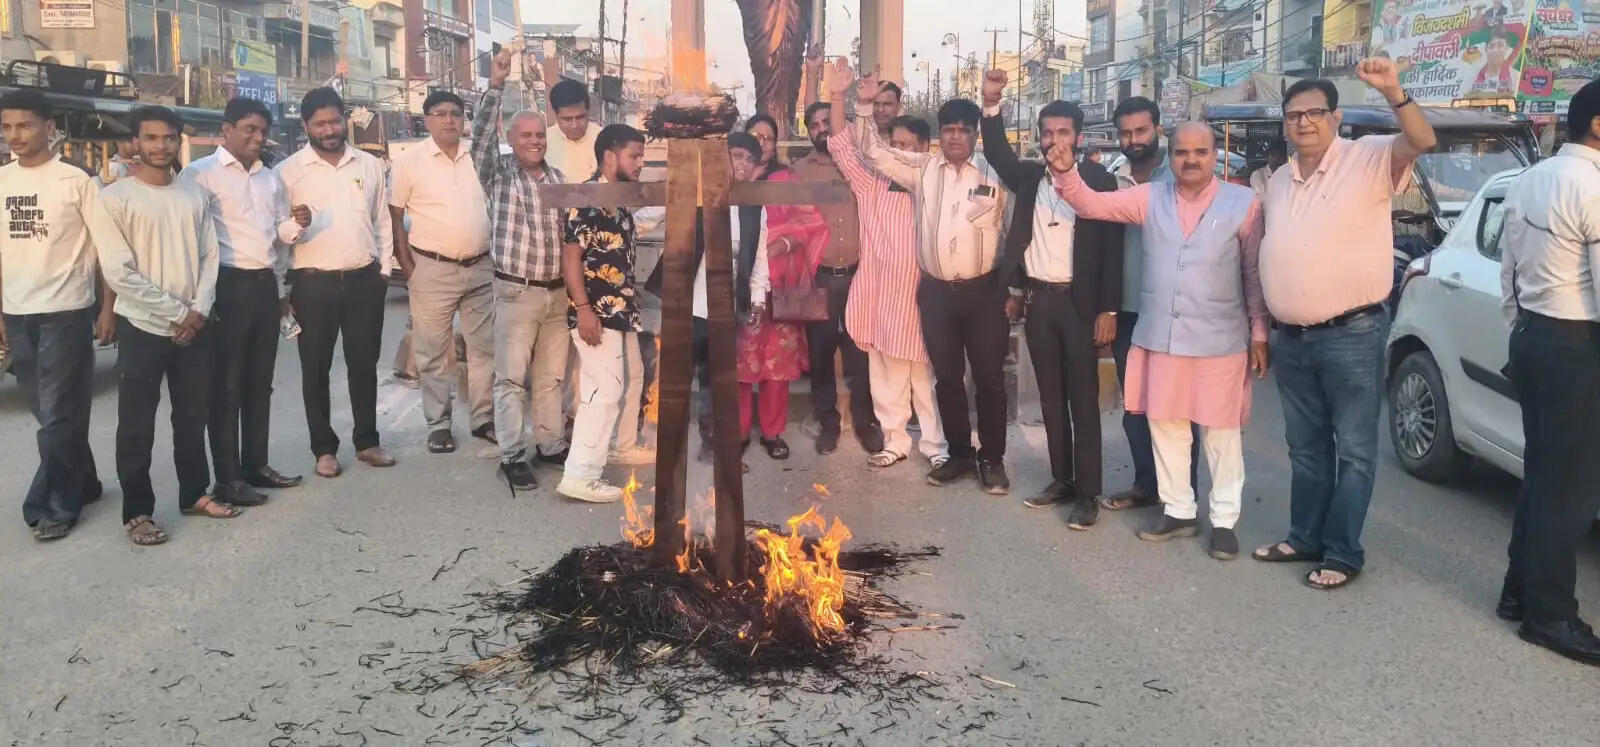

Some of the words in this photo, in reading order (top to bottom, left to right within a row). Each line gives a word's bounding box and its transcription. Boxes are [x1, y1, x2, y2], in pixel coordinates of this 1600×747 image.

[1412, 6, 1471, 36] विजयदशमी
[1411, 34, 1459, 63] दीपावली
[1406, 66, 1420, 83] की
[1423, 64, 1457, 84] हार्दिक
[5, 193, 37, 209] grand
[10, 209, 44, 220] theft
